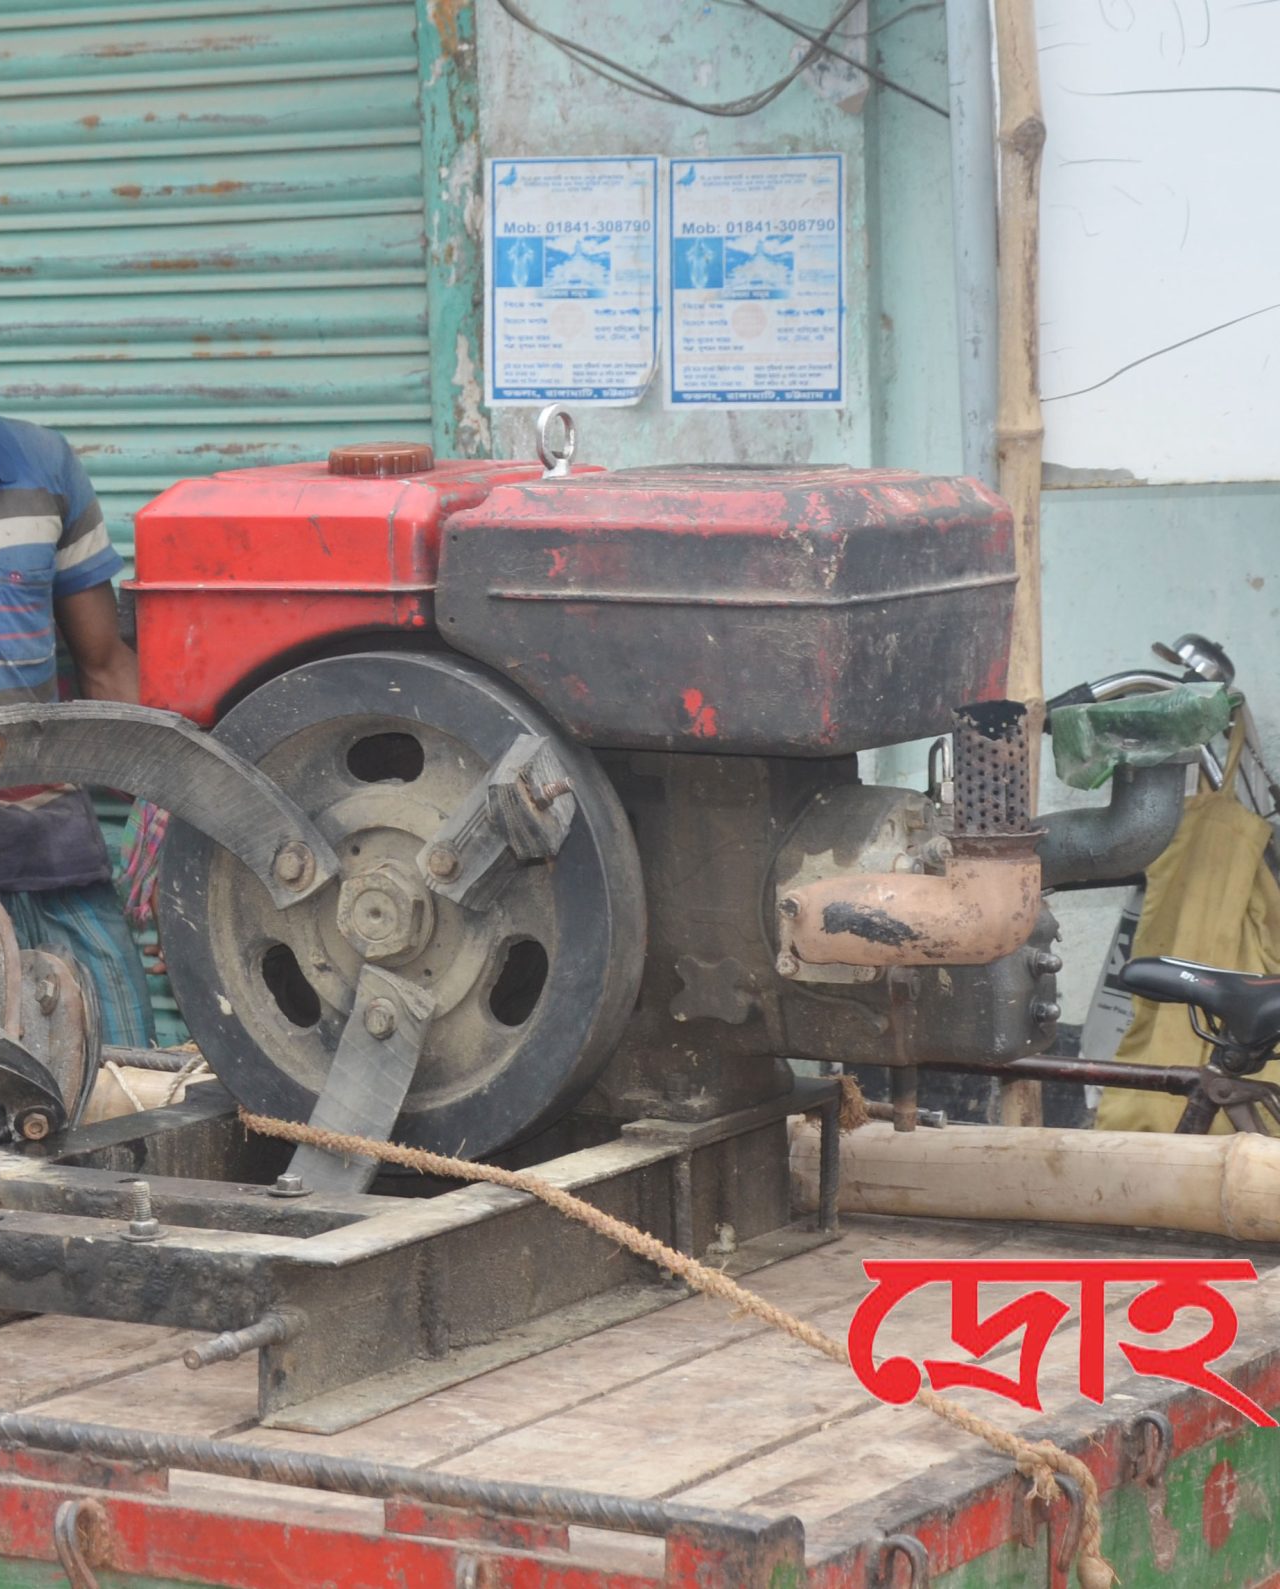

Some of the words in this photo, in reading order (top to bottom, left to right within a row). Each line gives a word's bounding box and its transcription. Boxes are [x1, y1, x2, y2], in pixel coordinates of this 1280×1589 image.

[504, 221, 541, 234] Mob:
[546, 219, 651, 233] 01841-308790
[682, 221, 719, 235] Mob:
[726, 218, 836, 233] 01841-308790
